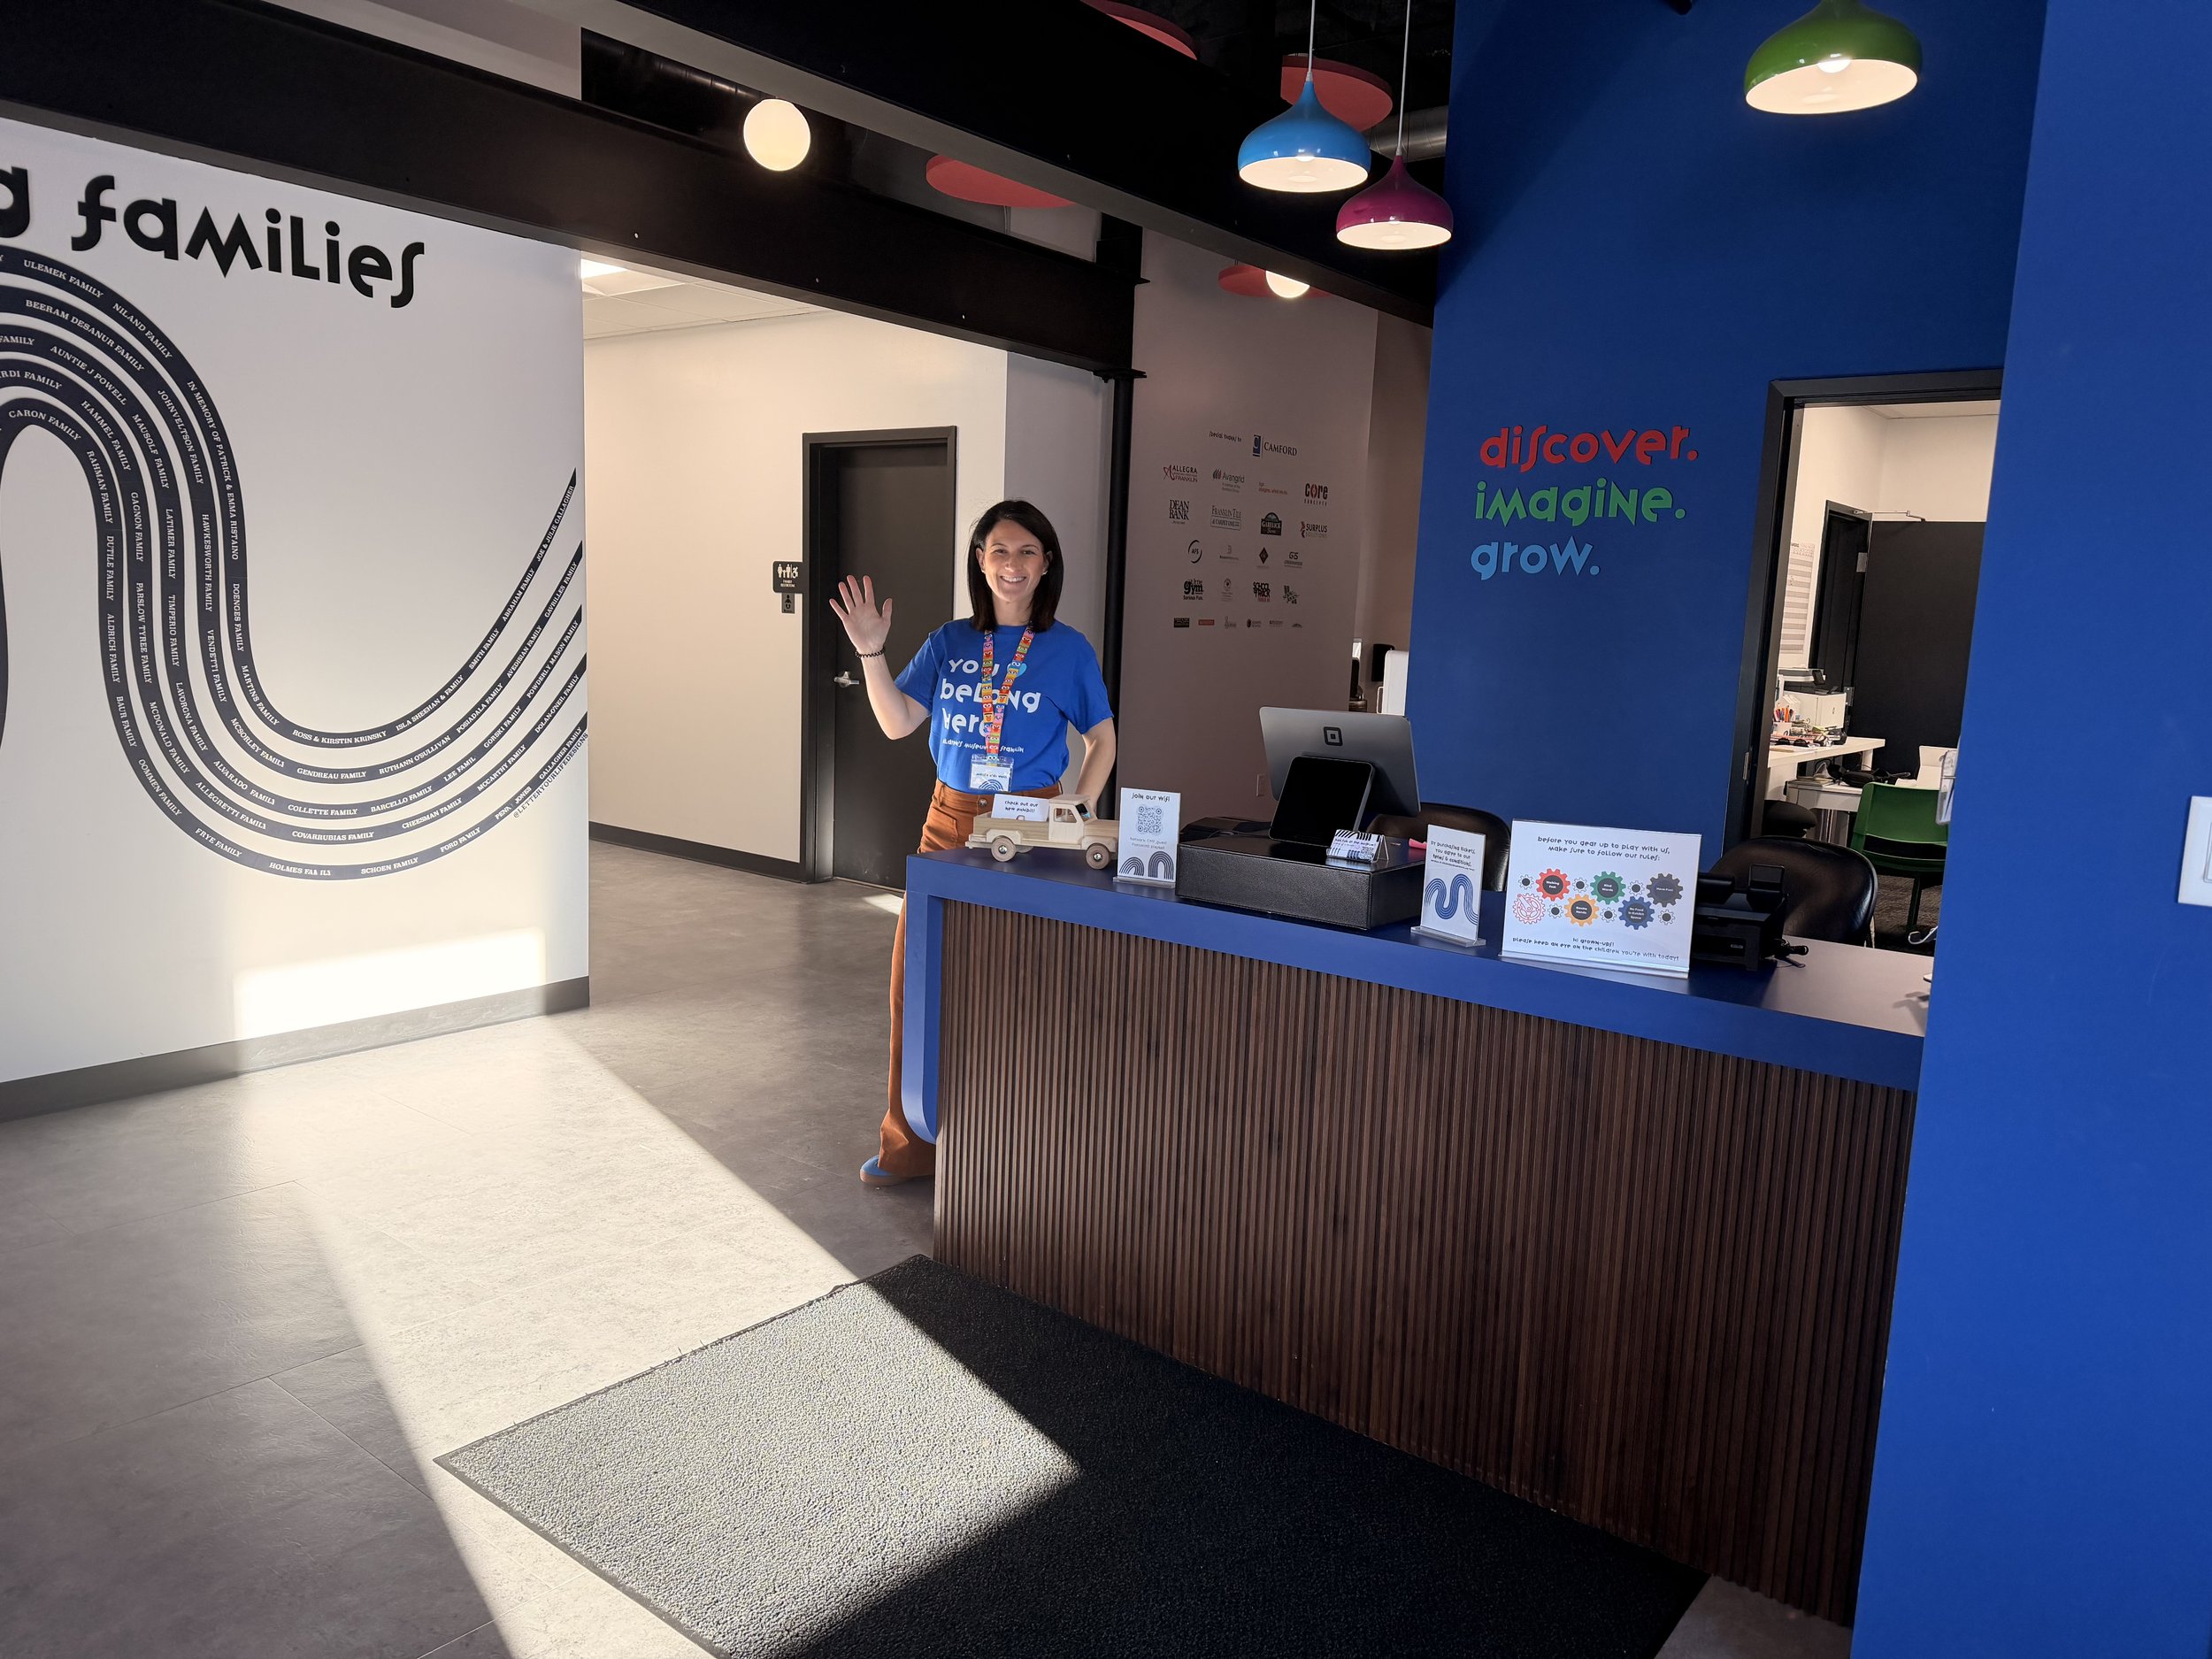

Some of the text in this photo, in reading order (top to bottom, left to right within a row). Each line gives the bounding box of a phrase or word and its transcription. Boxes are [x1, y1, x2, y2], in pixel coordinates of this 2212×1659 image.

[71, 175, 425, 308] families
[24, 259, 104, 298] ULEMEK FAMILY
[26, 299, 144, 372] BEERAM DESANUR FAMILY
[112, 303, 173, 359] NILAND FAMILY
[24, 371, 63, 390] FAMILY
[50, 345, 87, 370] AUNTIE
[94, 373, 127, 405] POWELL
[187, 380, 197, 391] IN
[8, 410, 81, 441] CARON FAMILY
[194, 391, 217, 430] MEMORY
[81, 401, 131, 471] HAMMEL FAMILY
[133, 414, 170, 488] MAUSOLF FAMILY
[211, 430, 221, 442] OF
[1263, 442, 1297, 456] CAMFORD
[1479, 425, 1699, 473] discover.
[189, 454, 204, 484] FAMILY
[216, 444, 232, 481] PATRICK
[1172, 465, 1197, 474] ALLEGRA
[1222, 472, 1245, 484] Avangrid
[86, 450, 113, 524] RAHMAN FAMILY
[227, 493, 236, 518] EMMA
[1169, 500, 1189, 511] DEAN
[1475, 477, 1686, 528] imagine.
[131, 492, 142, 530] GAGNON
[165, 508, 175, 547] LATIMER
[1169, 510, 1189, 520] BANK
[1306, 523, 1327, 533] SURPLUS
[202, 514, 212, 581] HAWKESWORTH
[230, 520, 239, 560] RISTAINO
[1471, 535, 1601, 580] grow.
[502, 568, 534, 622] ABRAHAM FAMILY
[544, 561, 577, 618] GAVRILLES FAMILY
[136, 582, 152, 684] PARSLOW TYREE FAMILY
[168, 595, 180, 667] TIMPERIO FAMILY
[233, 583, 244, 652] DOENGES FAMILY
[107, 613, 120, 683] ALDRICH FAMILY
[207, 629, 227, 703] VENDETTI FAMILY
[468, 628, 500, 670] SMITH FAMILY
[506, 625, 542, 679] AVEDISIAN FAMILY
[526, 619, 579, 699] POWDERLY MASON FAMILY
[241, 665, 280, 726] MARTINS FAMILY
[396, 718, 412, 731] ISLA
[411, 698, 442, 722] SHEEHAN
[445, 675, 464, 695] FAMILY
[564, 673, 580, 696] FAMILY
[116, 695, 137, 748] BAUR FAMILY
[176, 681, 209, 751] LAVORGNA FAMILY
[456, 682, 503, 733] POSIADALA FAMILY
[483, 705, 522, 749] GORSKI FAMILY
[150, 702, 191, 774] MCDONALD FAMILY
[292, 729, 312, 741] ROSS
[354, 730, 387, 743] KRINSKY
[379, 735, 451, 775] RUTHANN O'SULLIVAN
[539, 726, 583, 780] GALLAGHER FAMILY
[138, 759, 182, 816] OOMMEN FAMILY
[296, 767, 367, 780] GENDREAU FAMILY
[477, 744, 526, 792] MCCARTHY FAMILY
[288, 804, 329, 816] COLLETTE
[371, 785, 433, 812] BARCELLO FAMILY
[402, 797, 463, 829] CHEESMAN FAMILY
[196, 827, 242, 857] FRYE FAMILY
[292, 830, 374, 841] COVARRUBIAS FAMILY
[361, 857, 419, 875] SCHOEN FAMILY
